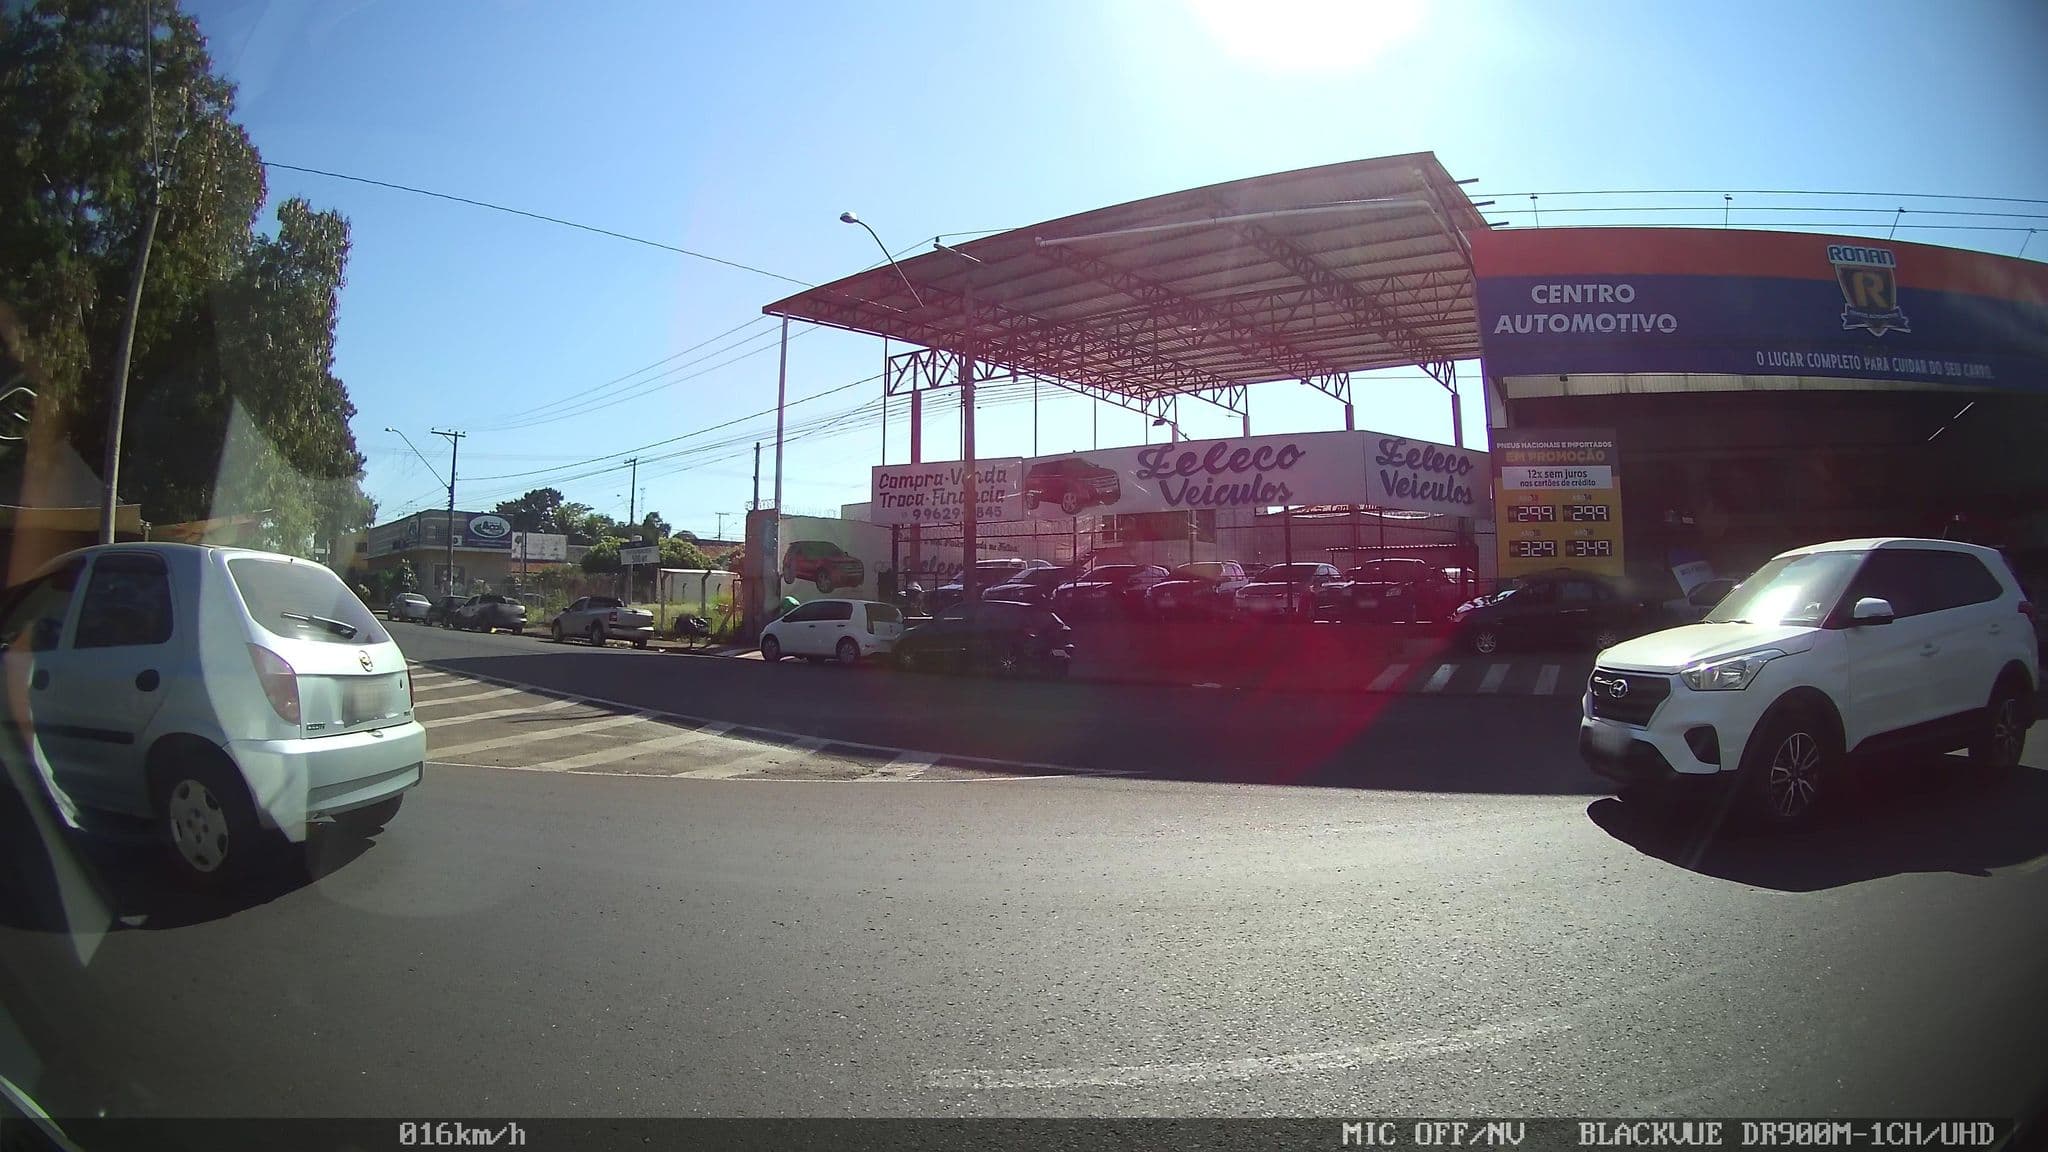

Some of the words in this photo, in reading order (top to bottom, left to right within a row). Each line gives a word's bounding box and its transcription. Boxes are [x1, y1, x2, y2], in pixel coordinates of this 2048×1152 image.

[1828, 246, 1895, 265] RONAN
[1530, 283, 1636, 304] CENTRO
[1852, 272, 1889, 308] R
[1493, 312, 1678, 334] AUTOMOTIVO
[1756, 350, 1764, 366] O
[1767, 351, 1804, 368] LUGAR
[1806, 352, 1862, 370] COMPLETO
[1864, 356, 1890, 372] PARA
[1893, 357, 1928, 375] CUIDAR
[1929, 360, 1942, 375] DO
[1944, 361, 1963, 377] SEU
[1521, 441, 1560, 449] NACIONAIS
[950, 465, 1008, 485] Vnda
[1528, 469, 1543, 479] 12x
[1544, 470, 1564, 479] sem
[1565, 468, 1588, 480] juros
[1534, 479, 1561, 488] cartões
[1561, 479, 1570, 487] de
[1571, 479, 1597, 487] crédito
[1517, 506, 1553, 522] 299
[1572, 505, 1607, 521] 299
[1519, 541, 1555, 557] 329
[1575, 540, 1610, 556] 349
